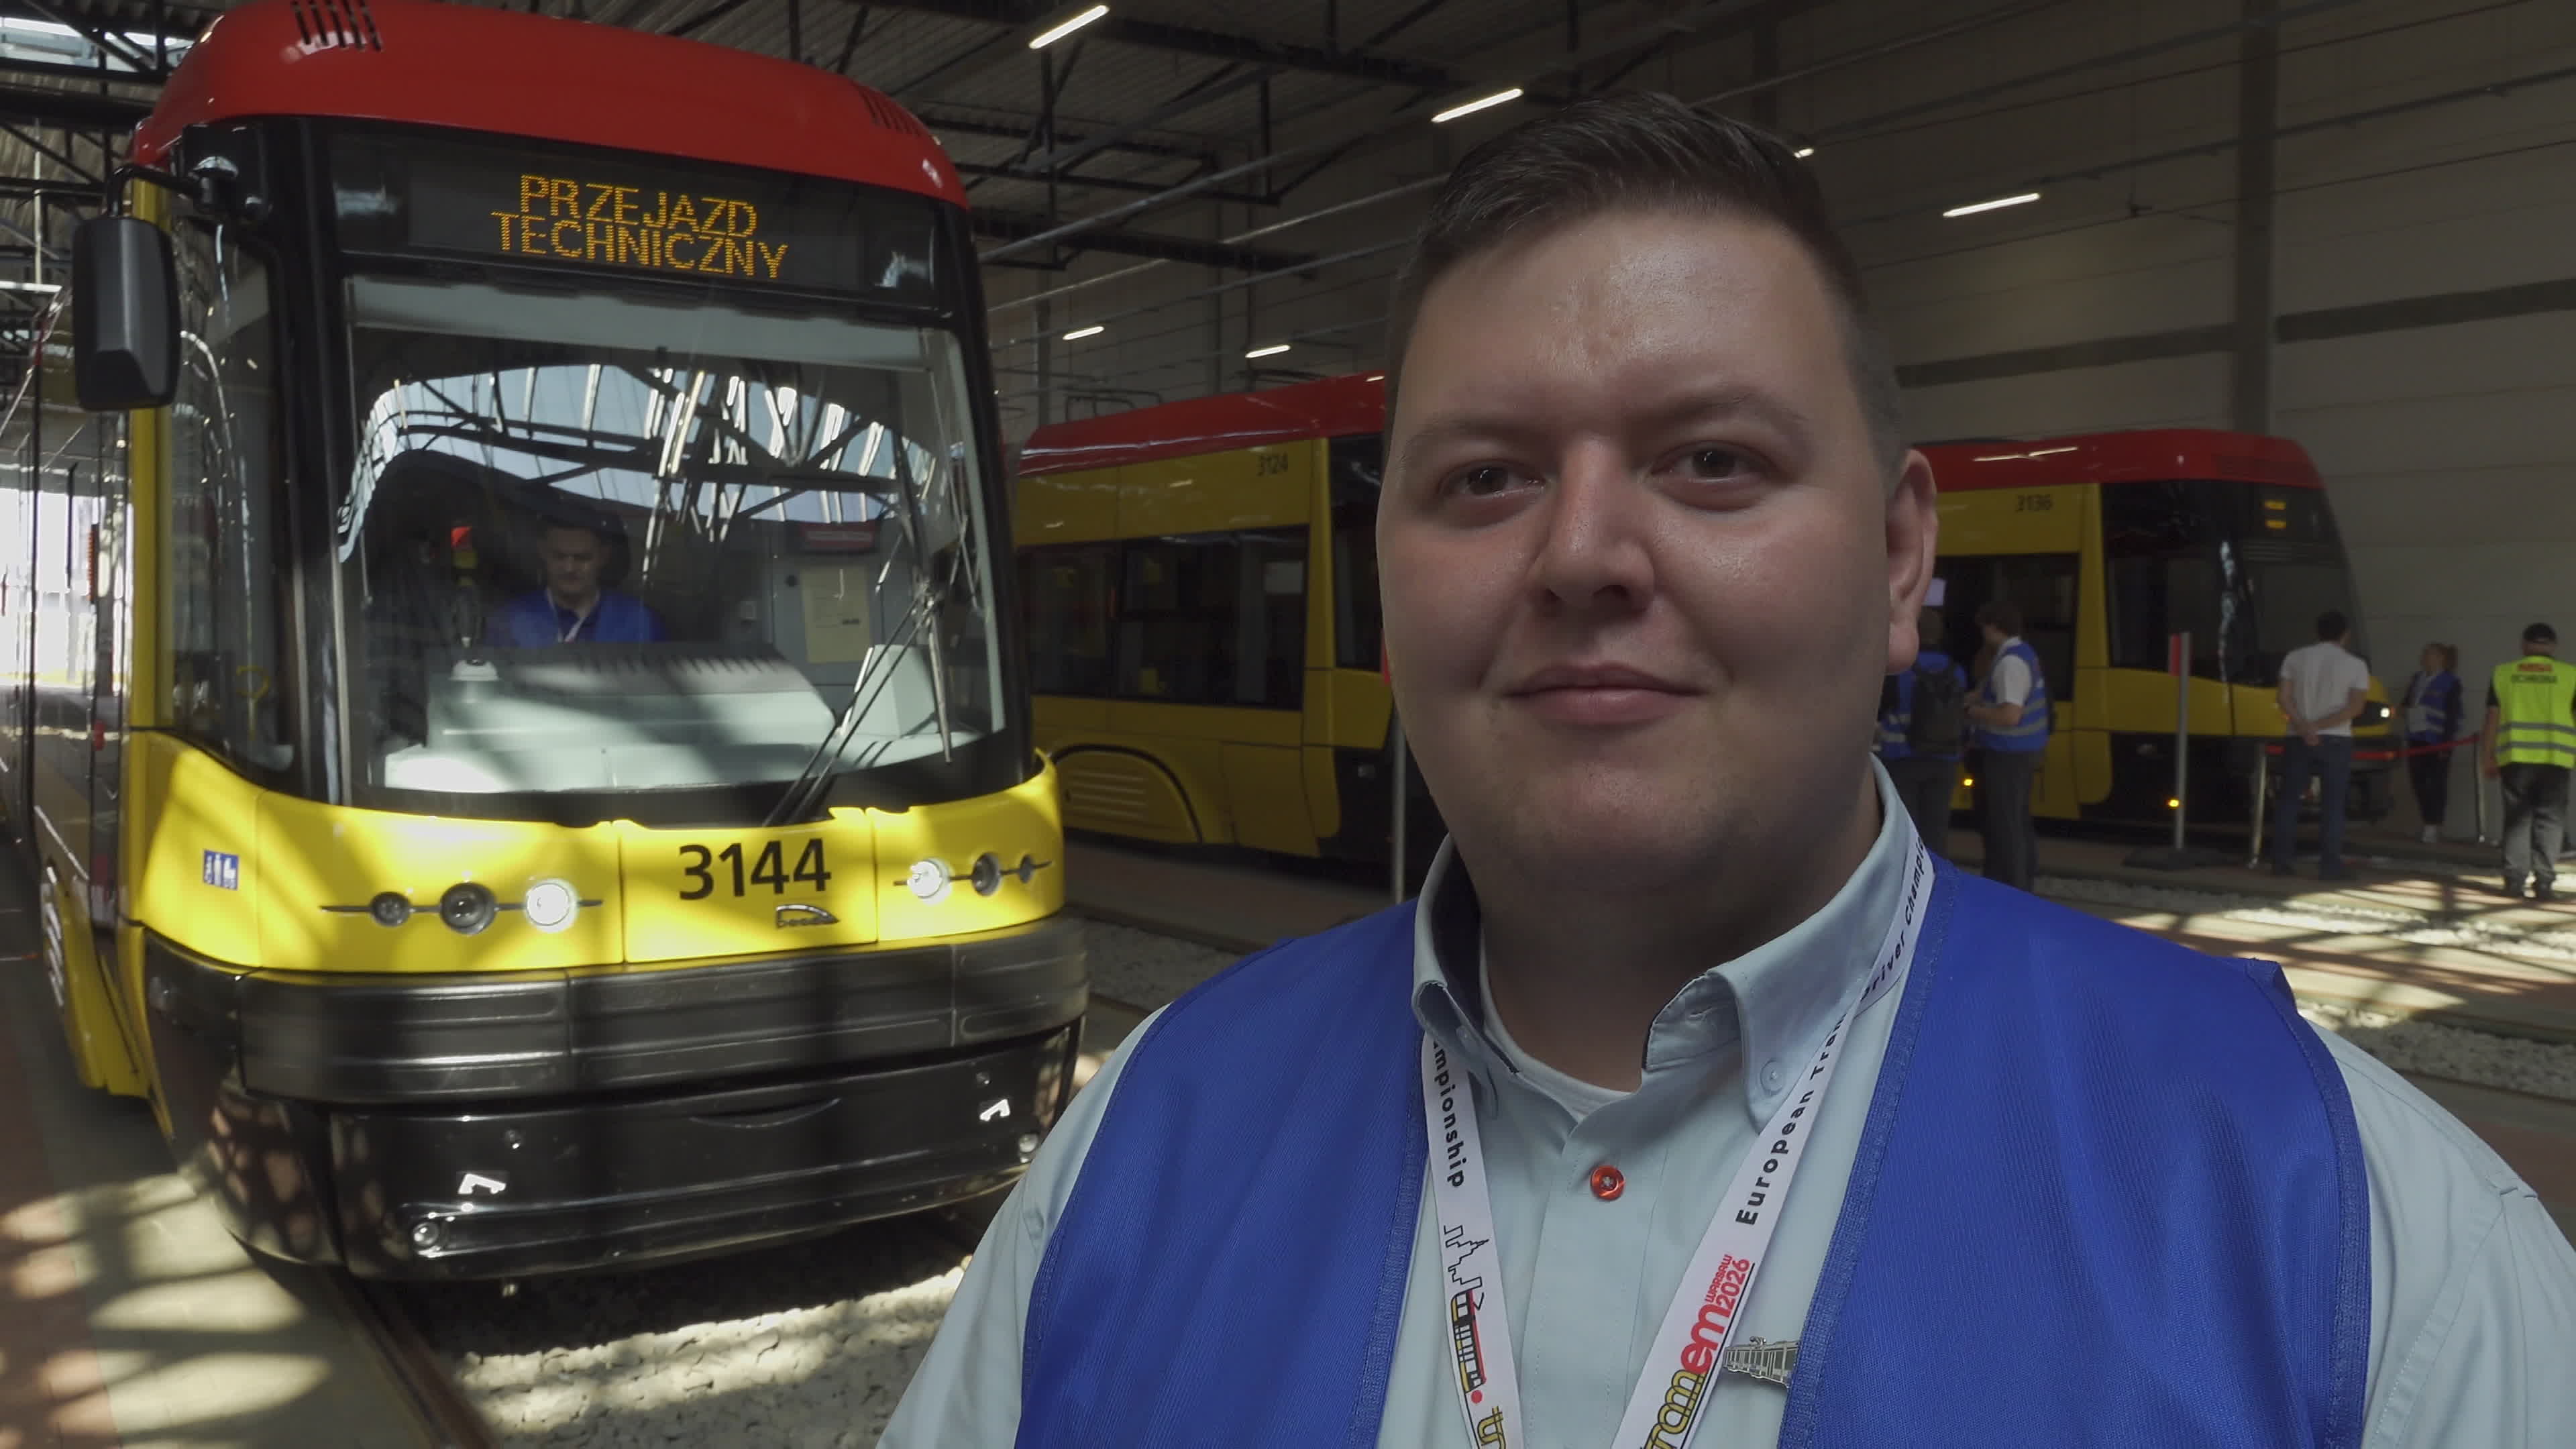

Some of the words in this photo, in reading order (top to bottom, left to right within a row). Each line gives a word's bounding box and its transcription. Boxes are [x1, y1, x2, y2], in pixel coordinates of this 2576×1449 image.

[520, 174, 758, 238] PRZEJAZD
[490, 210, 789, 279] TECHNICZNY
[678, 837, 832, 900] 3144
[1735, 1089, 1815, 1226] European
[1704, 1253, 1733, 1303] WARSAW
[1715, 1258, 1750, 1311] 2026
